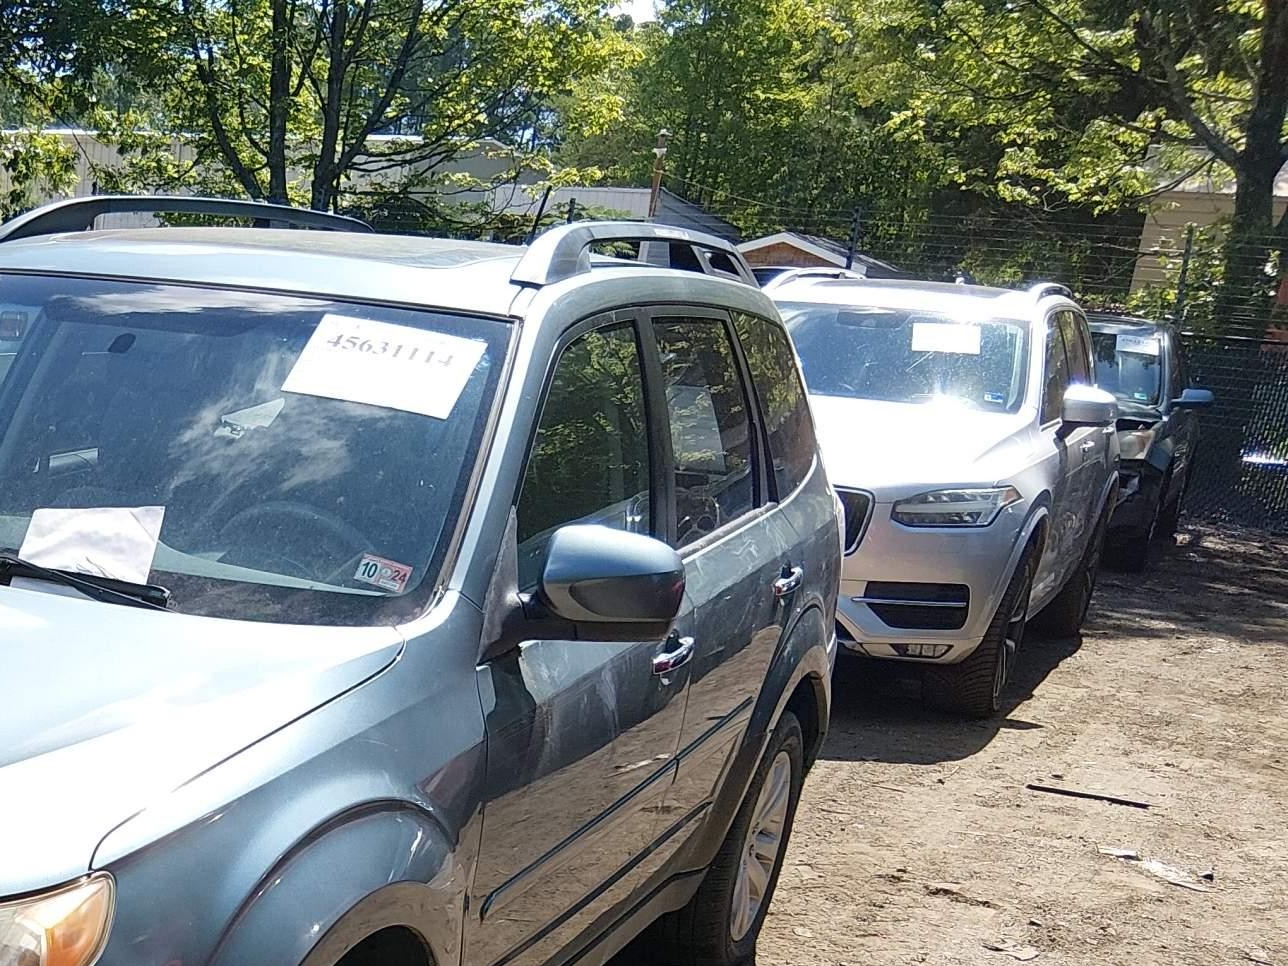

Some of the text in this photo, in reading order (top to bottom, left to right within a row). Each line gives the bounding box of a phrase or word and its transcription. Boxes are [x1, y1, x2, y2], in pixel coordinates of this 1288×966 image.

[327, 333, 454, 368] 45631114
[361, 561, 408, 584] 10 24
